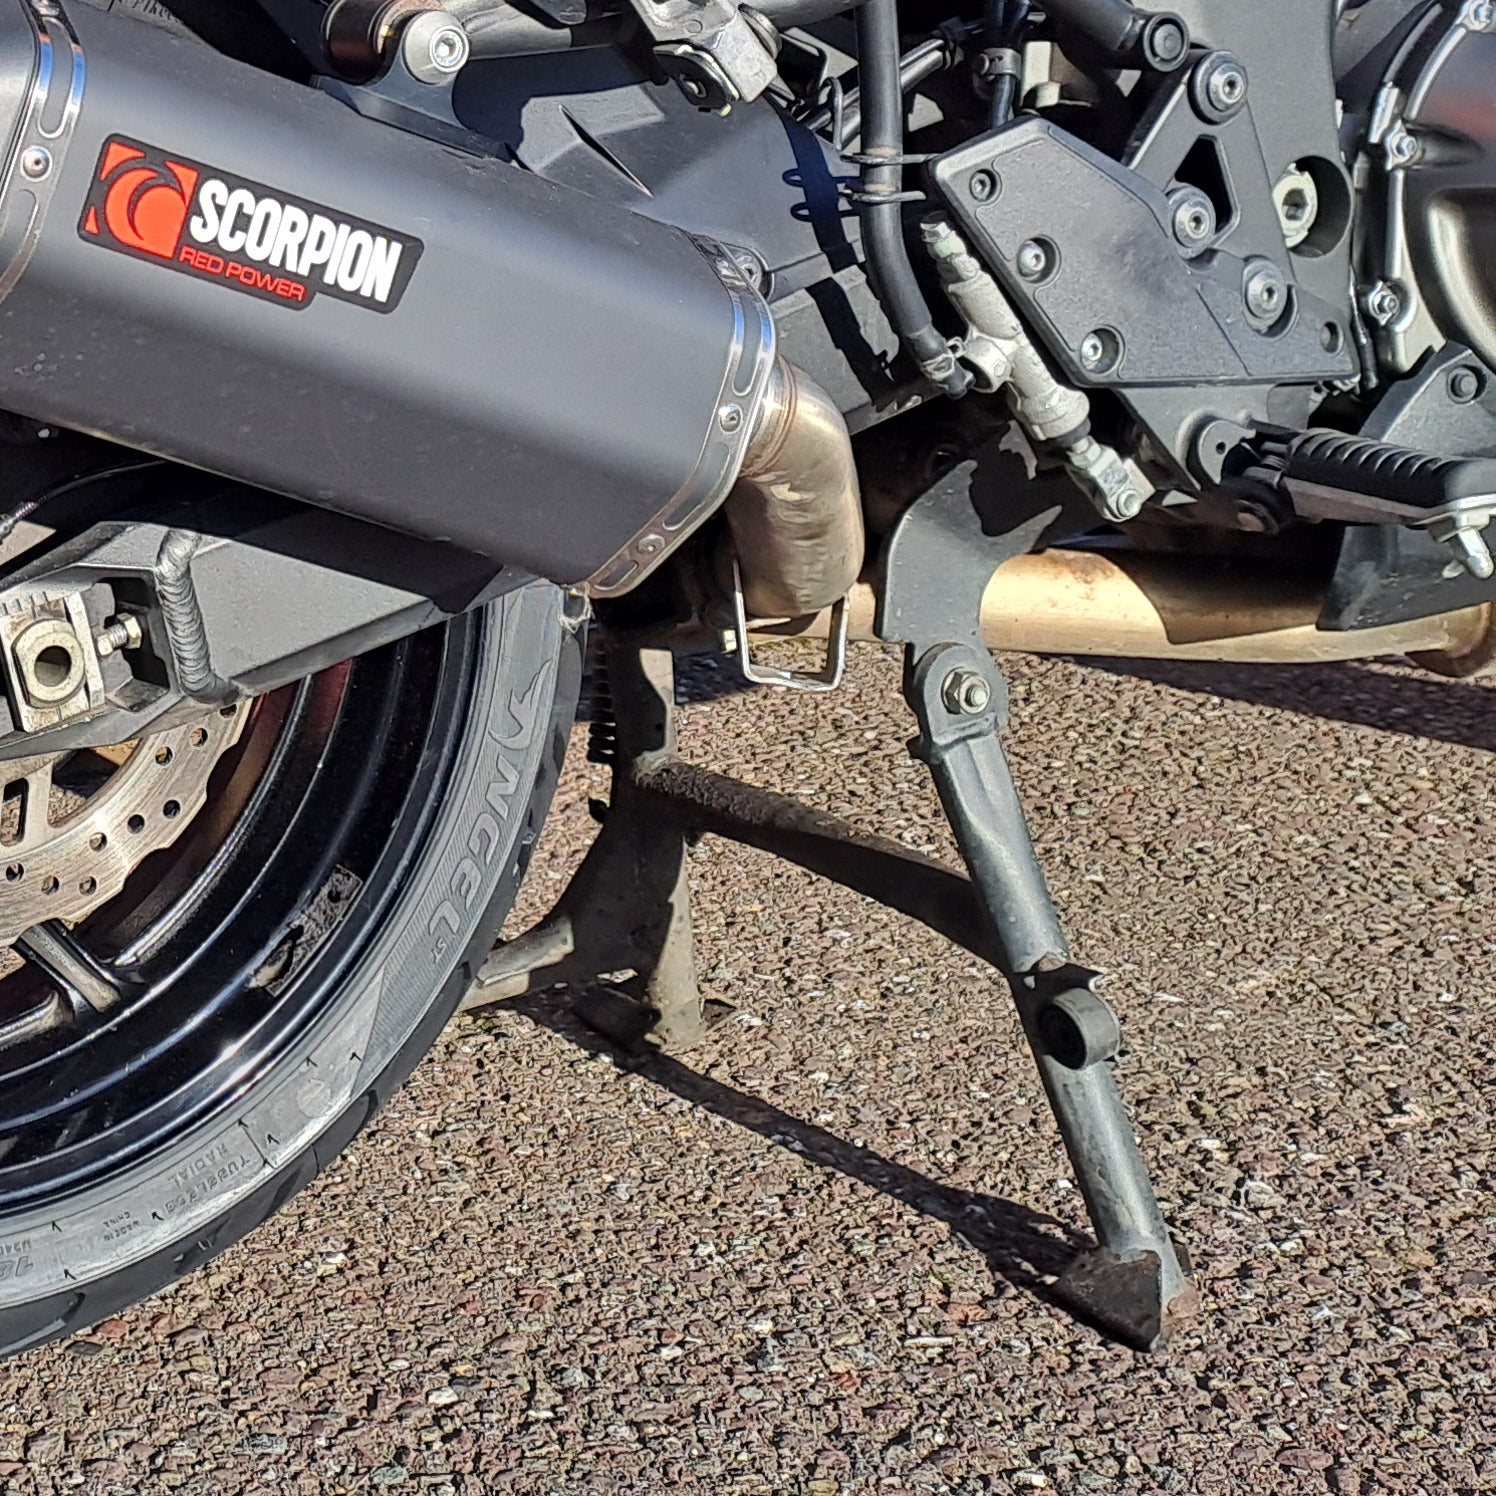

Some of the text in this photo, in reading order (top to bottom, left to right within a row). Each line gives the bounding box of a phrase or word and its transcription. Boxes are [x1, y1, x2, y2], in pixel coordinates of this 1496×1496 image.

[179, 245, 306, 301] RED POWER
[190, 179, 402, 303] SCORPION
